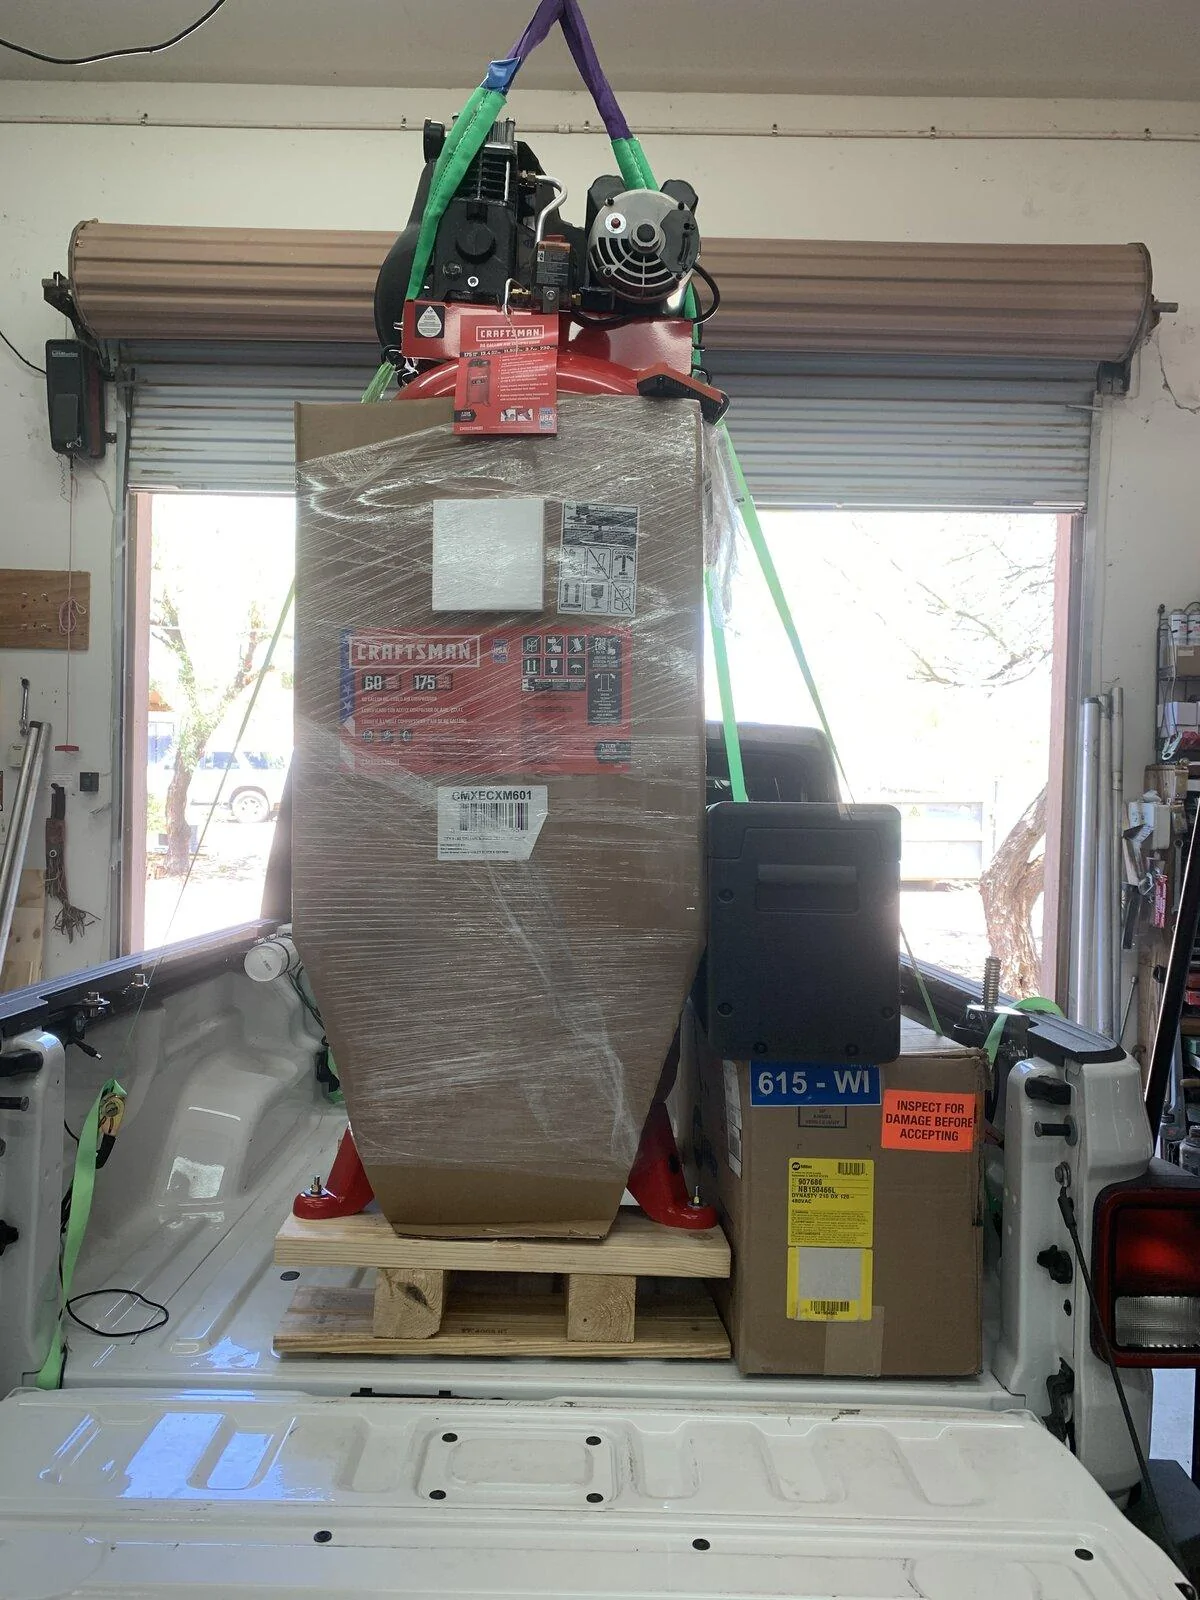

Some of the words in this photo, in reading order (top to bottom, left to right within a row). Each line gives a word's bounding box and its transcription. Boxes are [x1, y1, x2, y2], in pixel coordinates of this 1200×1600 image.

[480, 328, 540, 338] CRAFTSMAN
[357, 643, 471, 660] CRAFTSMAN
[364, 675, 382, 690] 60
[414, 675, 436, 690] 175
[452, 790, 532, 801] CMXECXM601
[758, 1071, 808, 1096] 615
[833, 1070, 870, 1094] WI
[896, 1100, 941, 1113] INSPECT
[944, 1103, 964, 1114] FOR
[885, 1115, 932, 1127] DAMAGE
[935, 1116, 973, 1128] BEFORE
[900, 1128, 959, 1142] ACCEPTING
